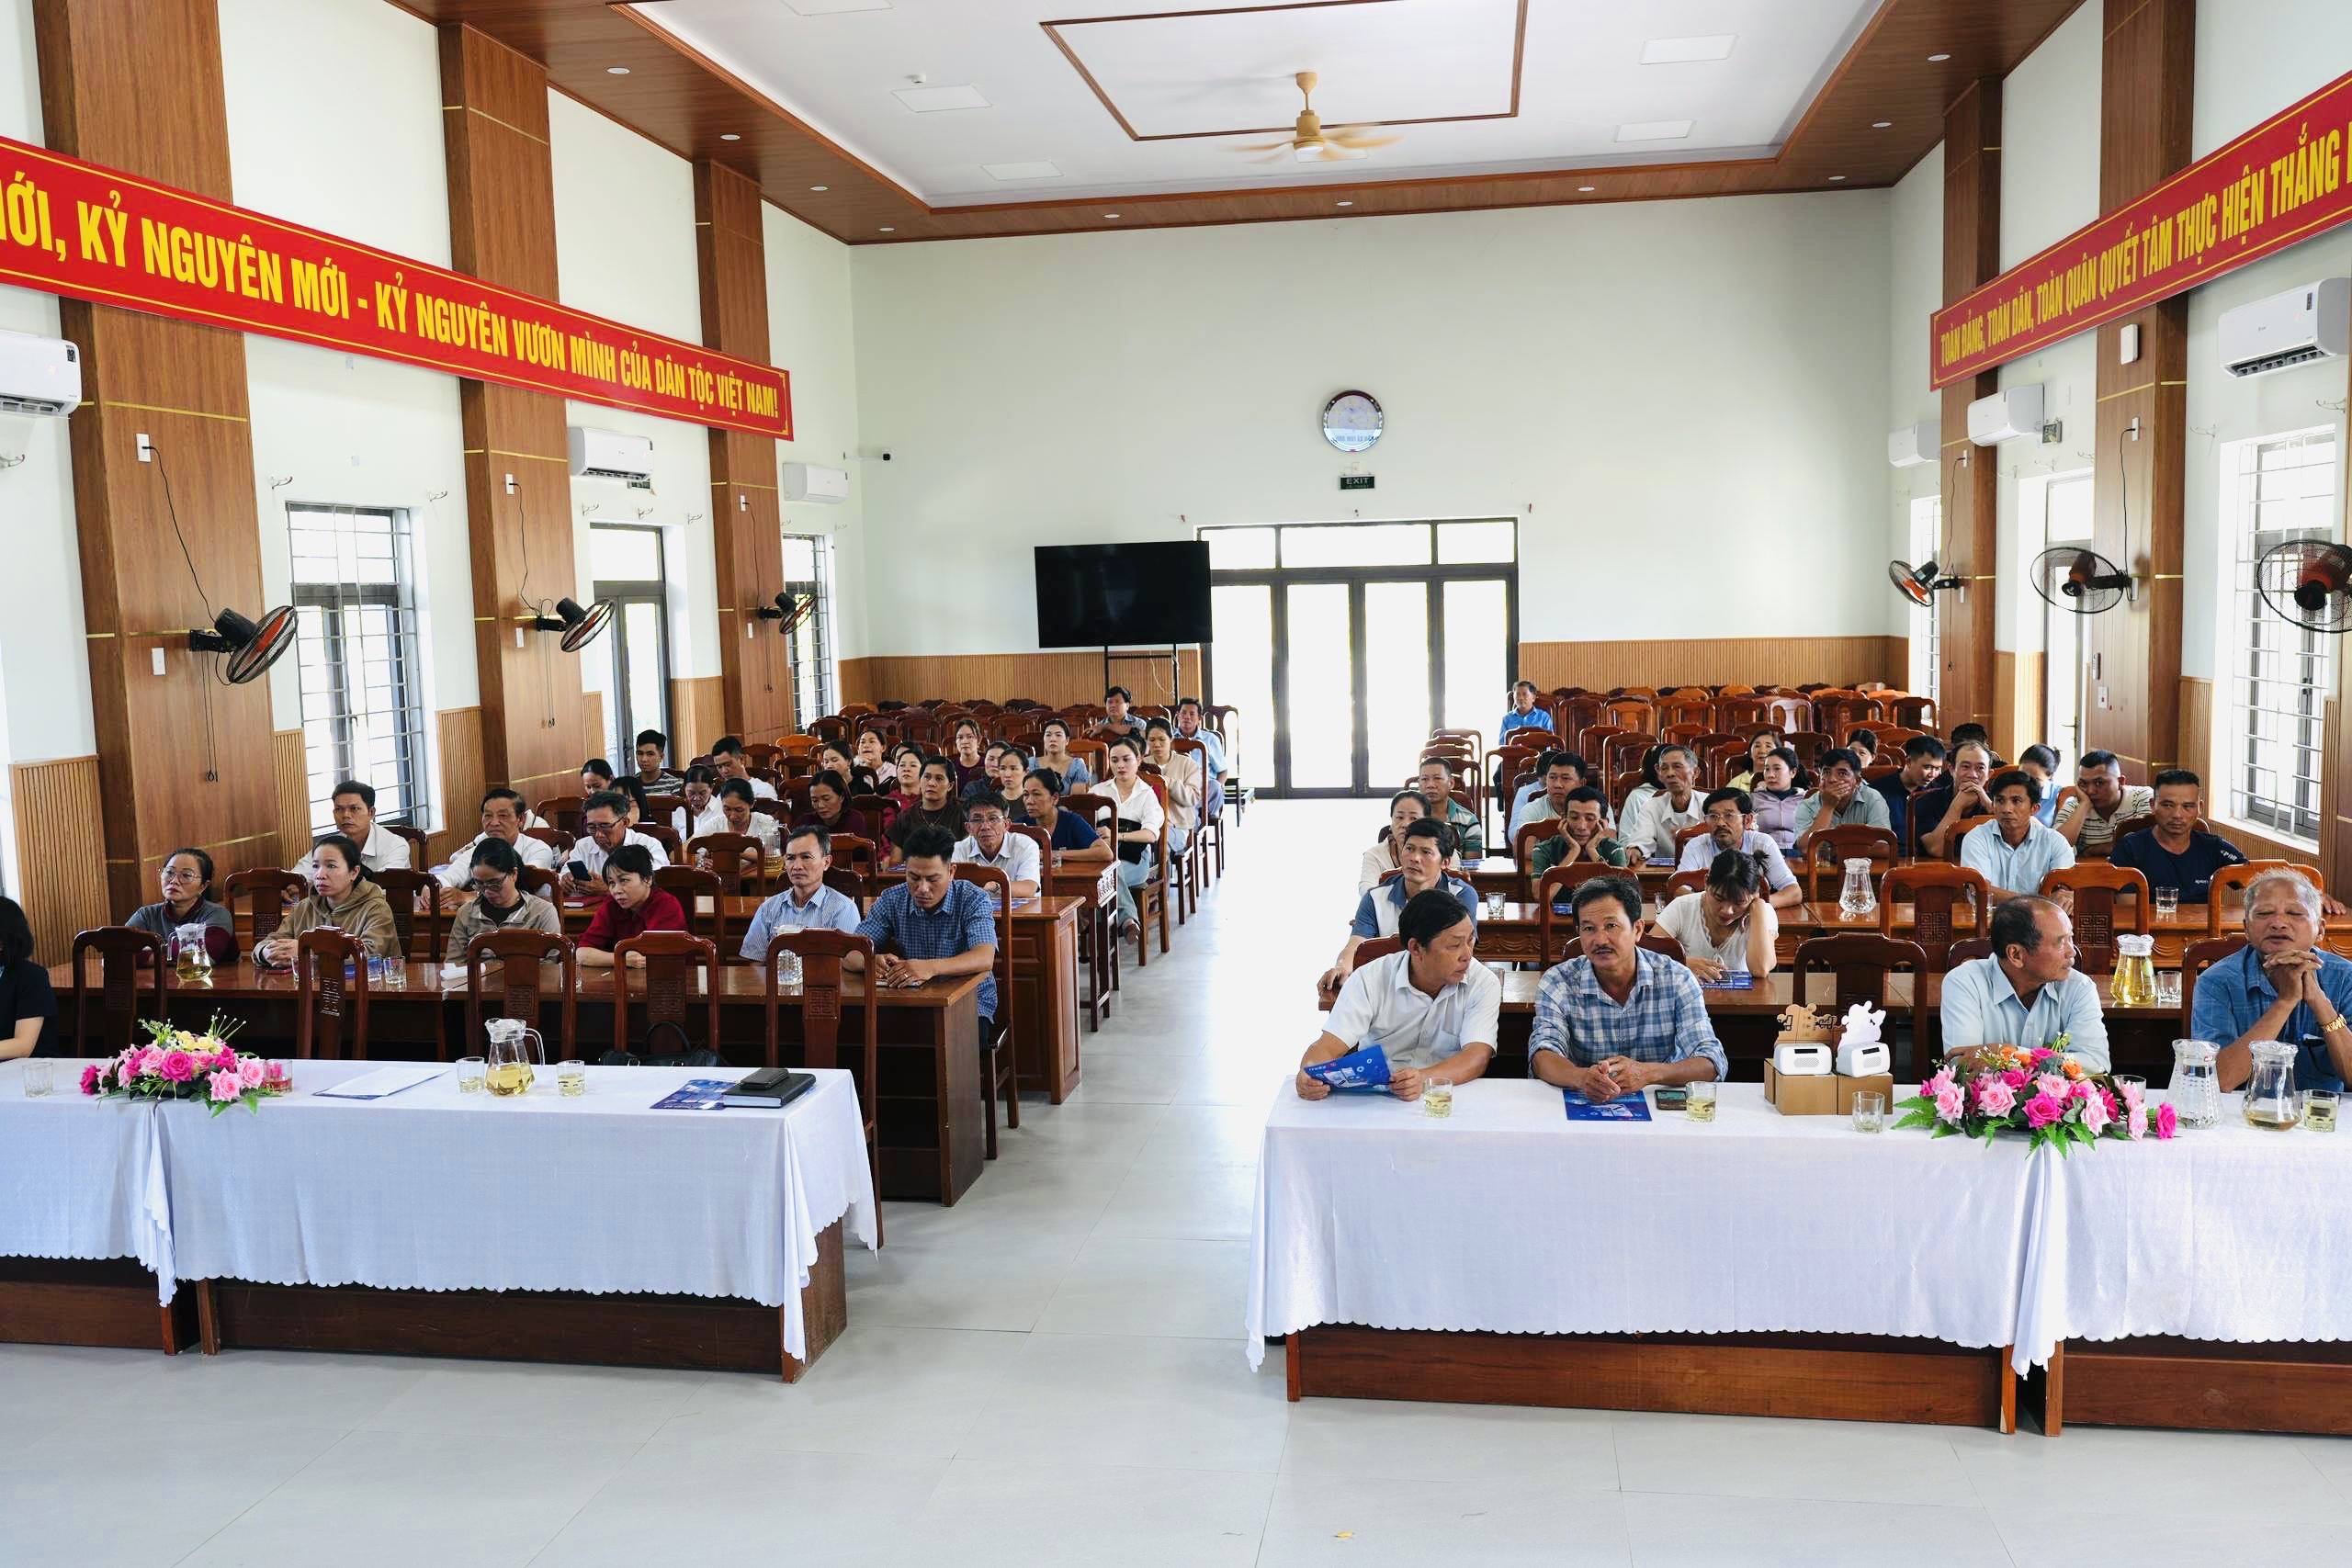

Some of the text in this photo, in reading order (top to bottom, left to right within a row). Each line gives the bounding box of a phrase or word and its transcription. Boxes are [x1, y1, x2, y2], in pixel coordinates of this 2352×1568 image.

[0, 171, 779, 418] ỚI, KỶ NGUYÊN MỚI - KỶ NGUYÊN VƯƠN MÌNH CỦA DÂN TỘC VIỆT NAM!
[1940, 323, 1961, 367] TOÀN
[1987, 298, 2010, 347] TOÀN
[2011, 286, 2034, 336] DÂN,
[2036, 270, 2064, 324] TOÀN
[2065, 253, 2098, 316] QUÂN
[2099, 221, 2140, 301] QUYẾT
[2142, 215, 2173, 277] TÂM
[2176, 192, 2218, 265] THỰC
[2221, 164, 2266, 246] HIỆN
[2270, 121, 2341, 219] THẮNG
[1346, 477, 1369, 485] EXIT
